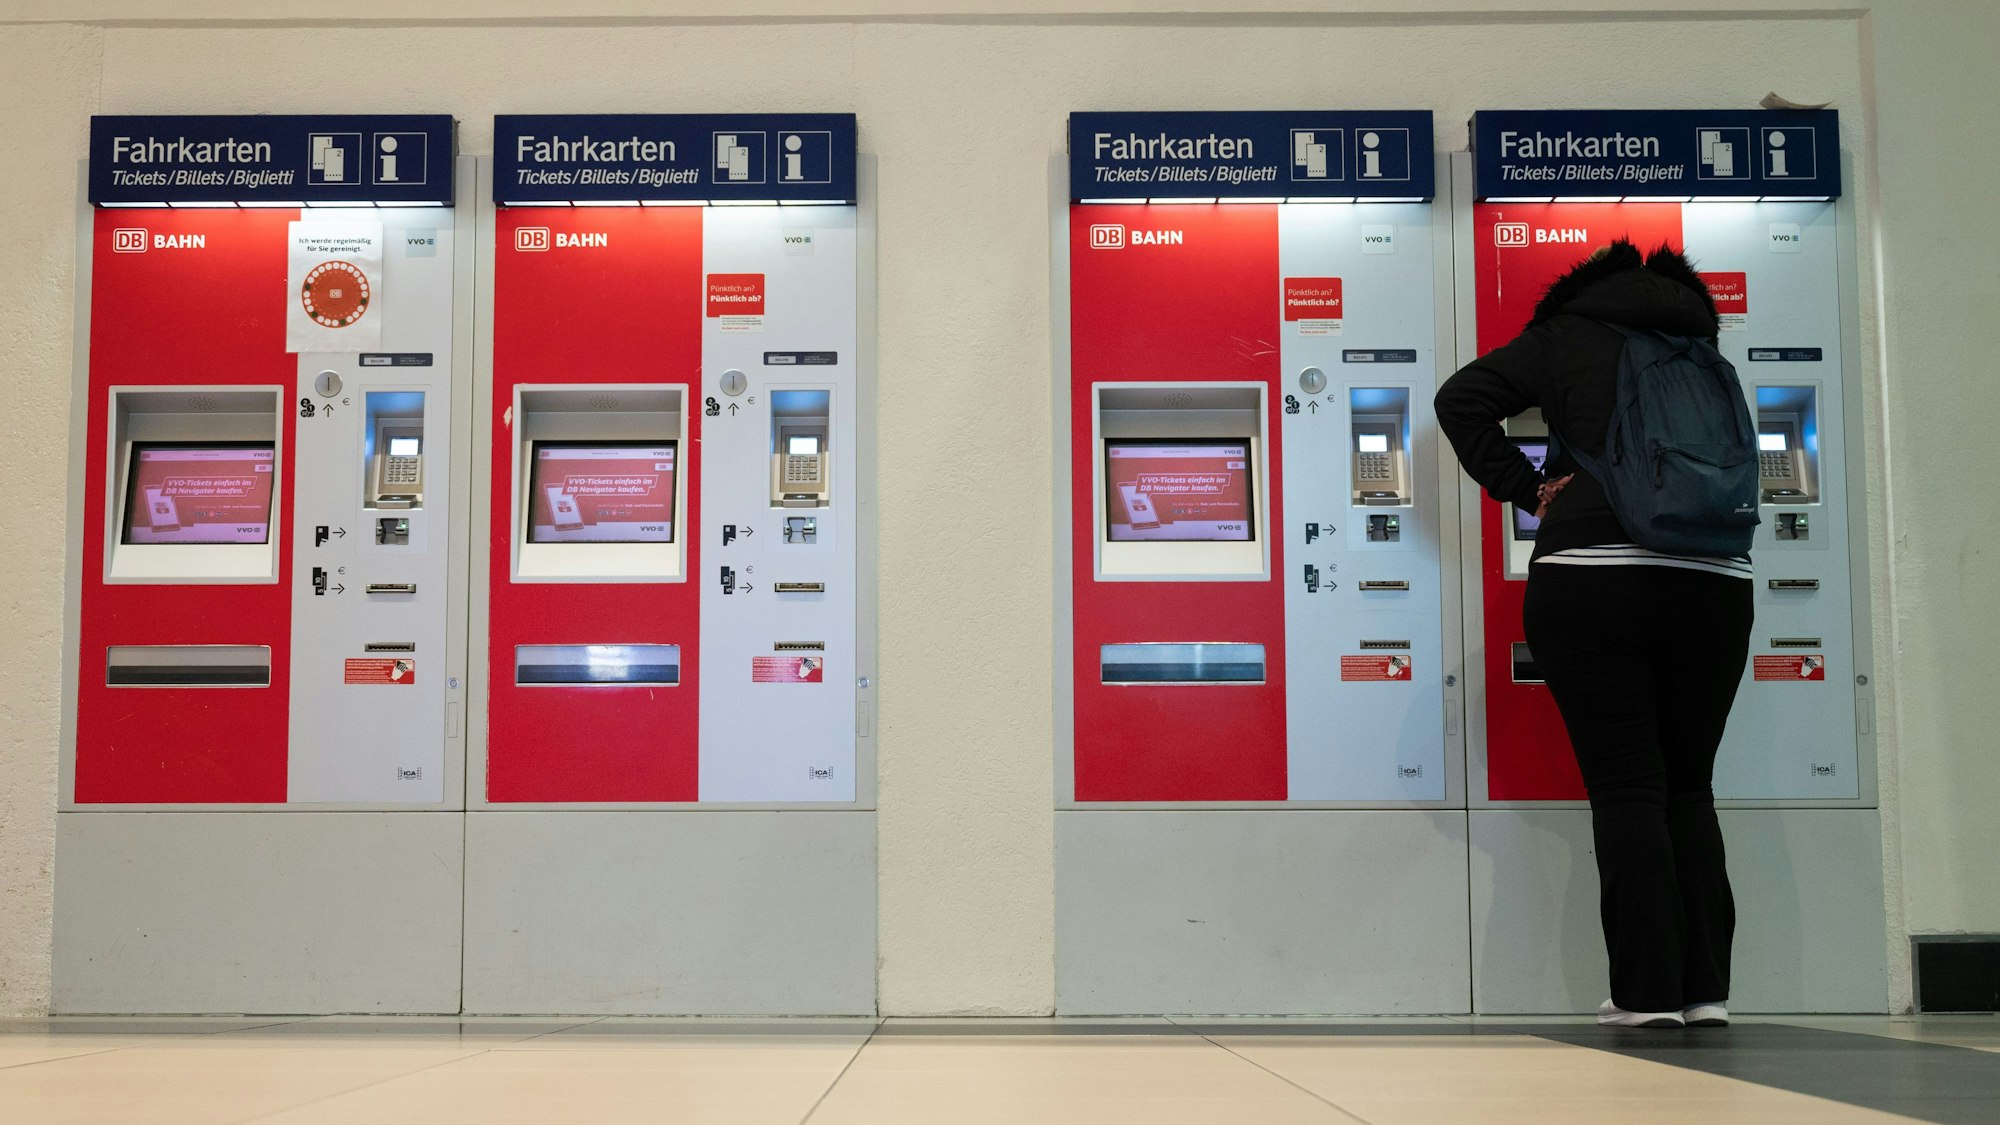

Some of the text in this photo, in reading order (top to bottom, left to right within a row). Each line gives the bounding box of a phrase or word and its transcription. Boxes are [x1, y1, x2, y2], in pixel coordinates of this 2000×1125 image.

[114, 137, 270, 163] Fahrkarten
[518, 136, 675, 162] Fahrkarten
[1095, 133, 1252, 159] Fahrkarten
[1501, 132, 1659, 158] Fahrkarten
[119, 233, 205, 248] DB BAHN
[333, 237, 372, 245] regelmäßig
[521, 232, 607, 246] DB BAHN
[1096, 229, 1182, 244] DB BAHN
[1500, 228, 1586, 242] DB BAHN
[614, 478, 641, 486] einfach
[1153, 485, 1190, 493] Navigator
[1191, 485, 1219, 493] kaufen.
[617, 486, 645, 494] kaufen.
